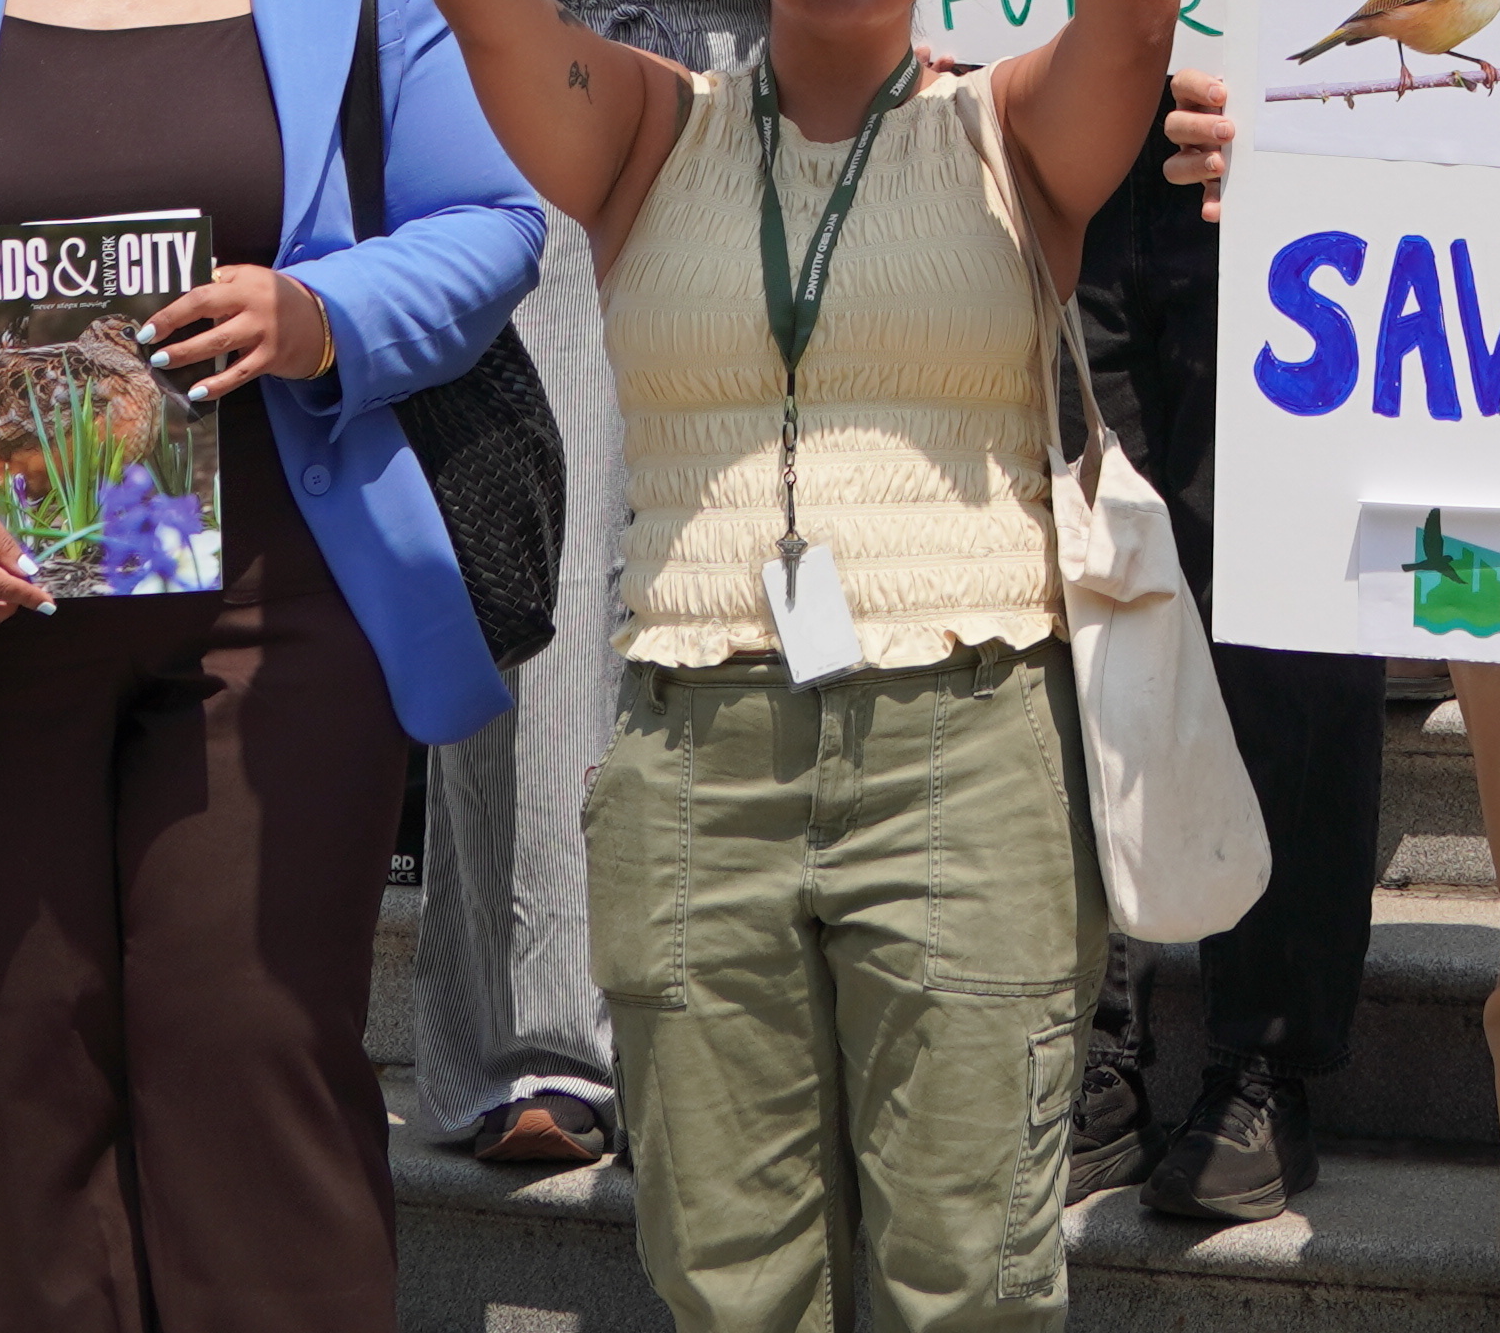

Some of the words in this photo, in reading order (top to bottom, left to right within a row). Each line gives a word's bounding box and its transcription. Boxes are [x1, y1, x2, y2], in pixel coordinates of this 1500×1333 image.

[824, 213, 840, 232] NYC
[53, 237, 99, 297] &
[102, 235, 116, 268] YORK
[118, 231, 197, 296] CITY
[103, 270, 117, 296] NEW
[804, 252, 825, 301] ALLIANCE
